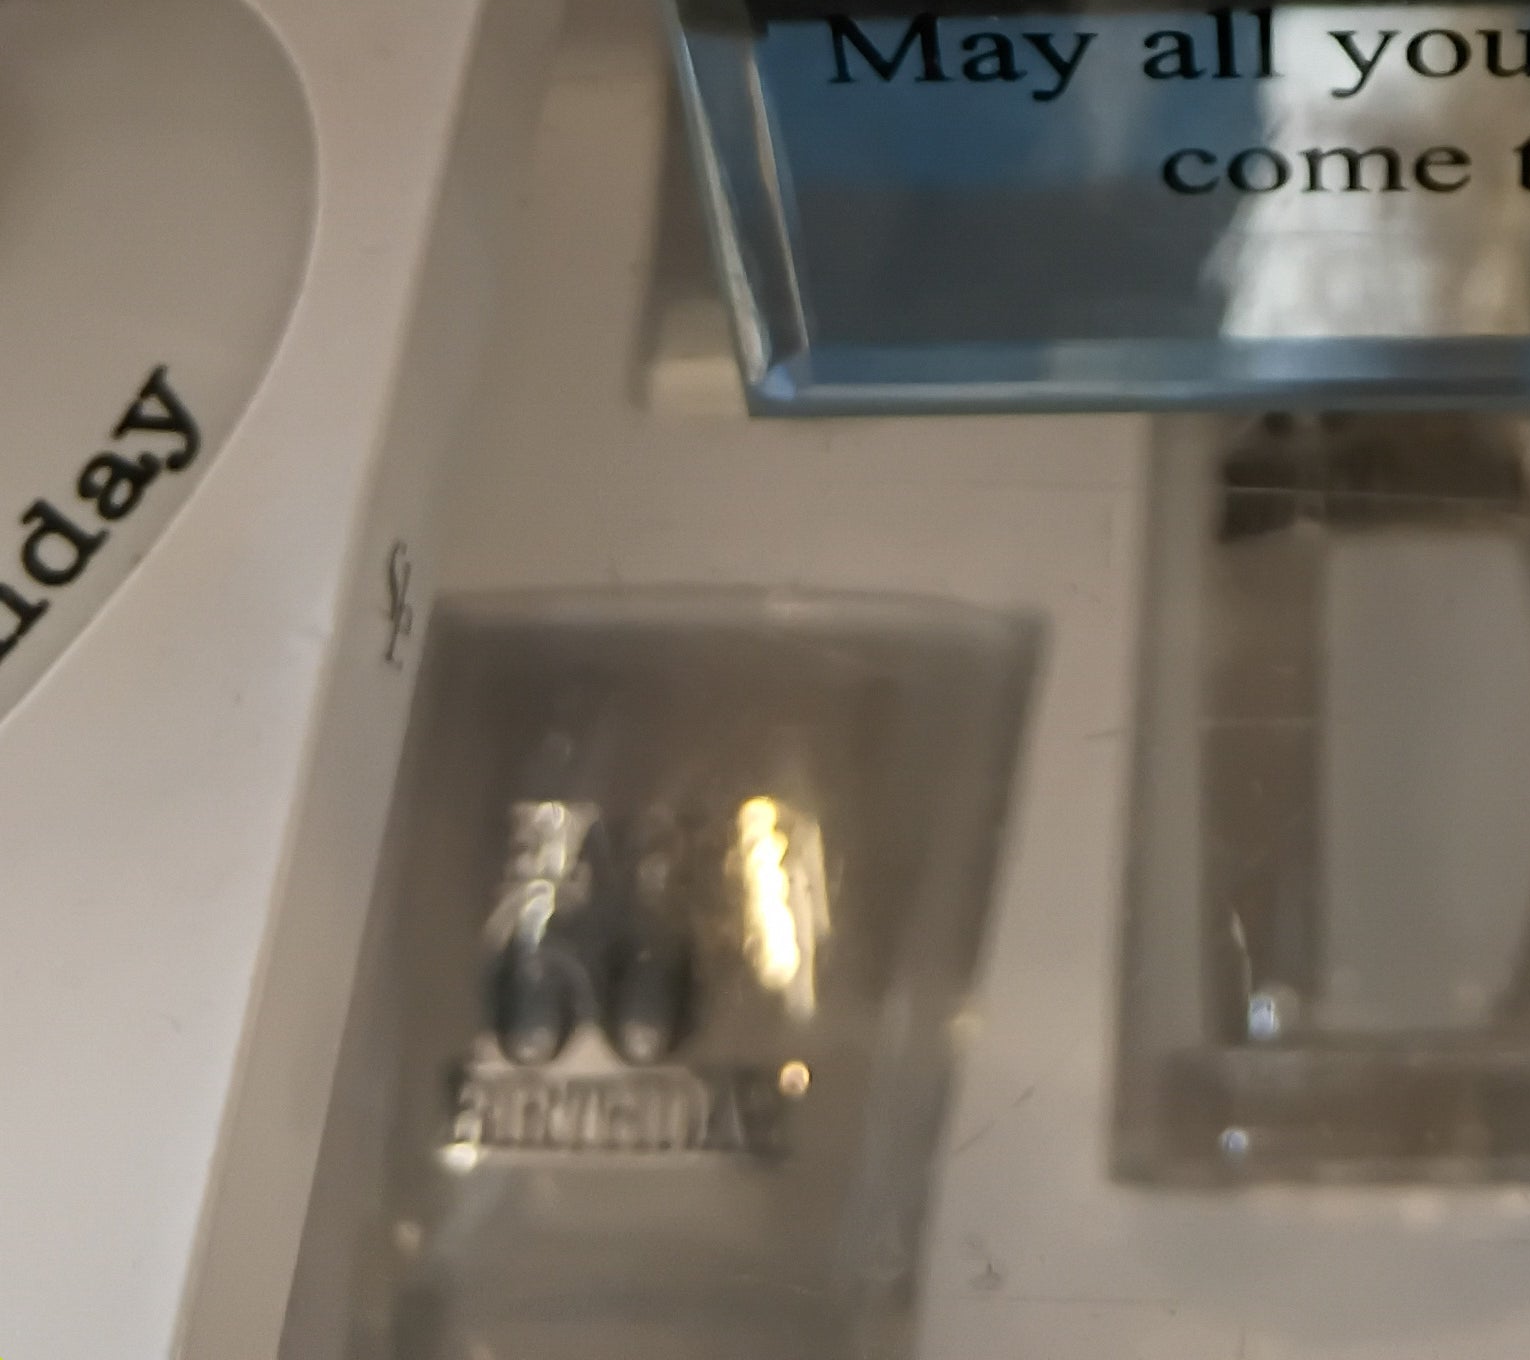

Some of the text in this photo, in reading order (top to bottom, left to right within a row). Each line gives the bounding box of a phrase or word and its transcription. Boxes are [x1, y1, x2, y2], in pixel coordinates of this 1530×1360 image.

[826, 12, 1096, 100] May
[1142, 6, 1281, 80] all
[1162, 143, 1472, 194] come
